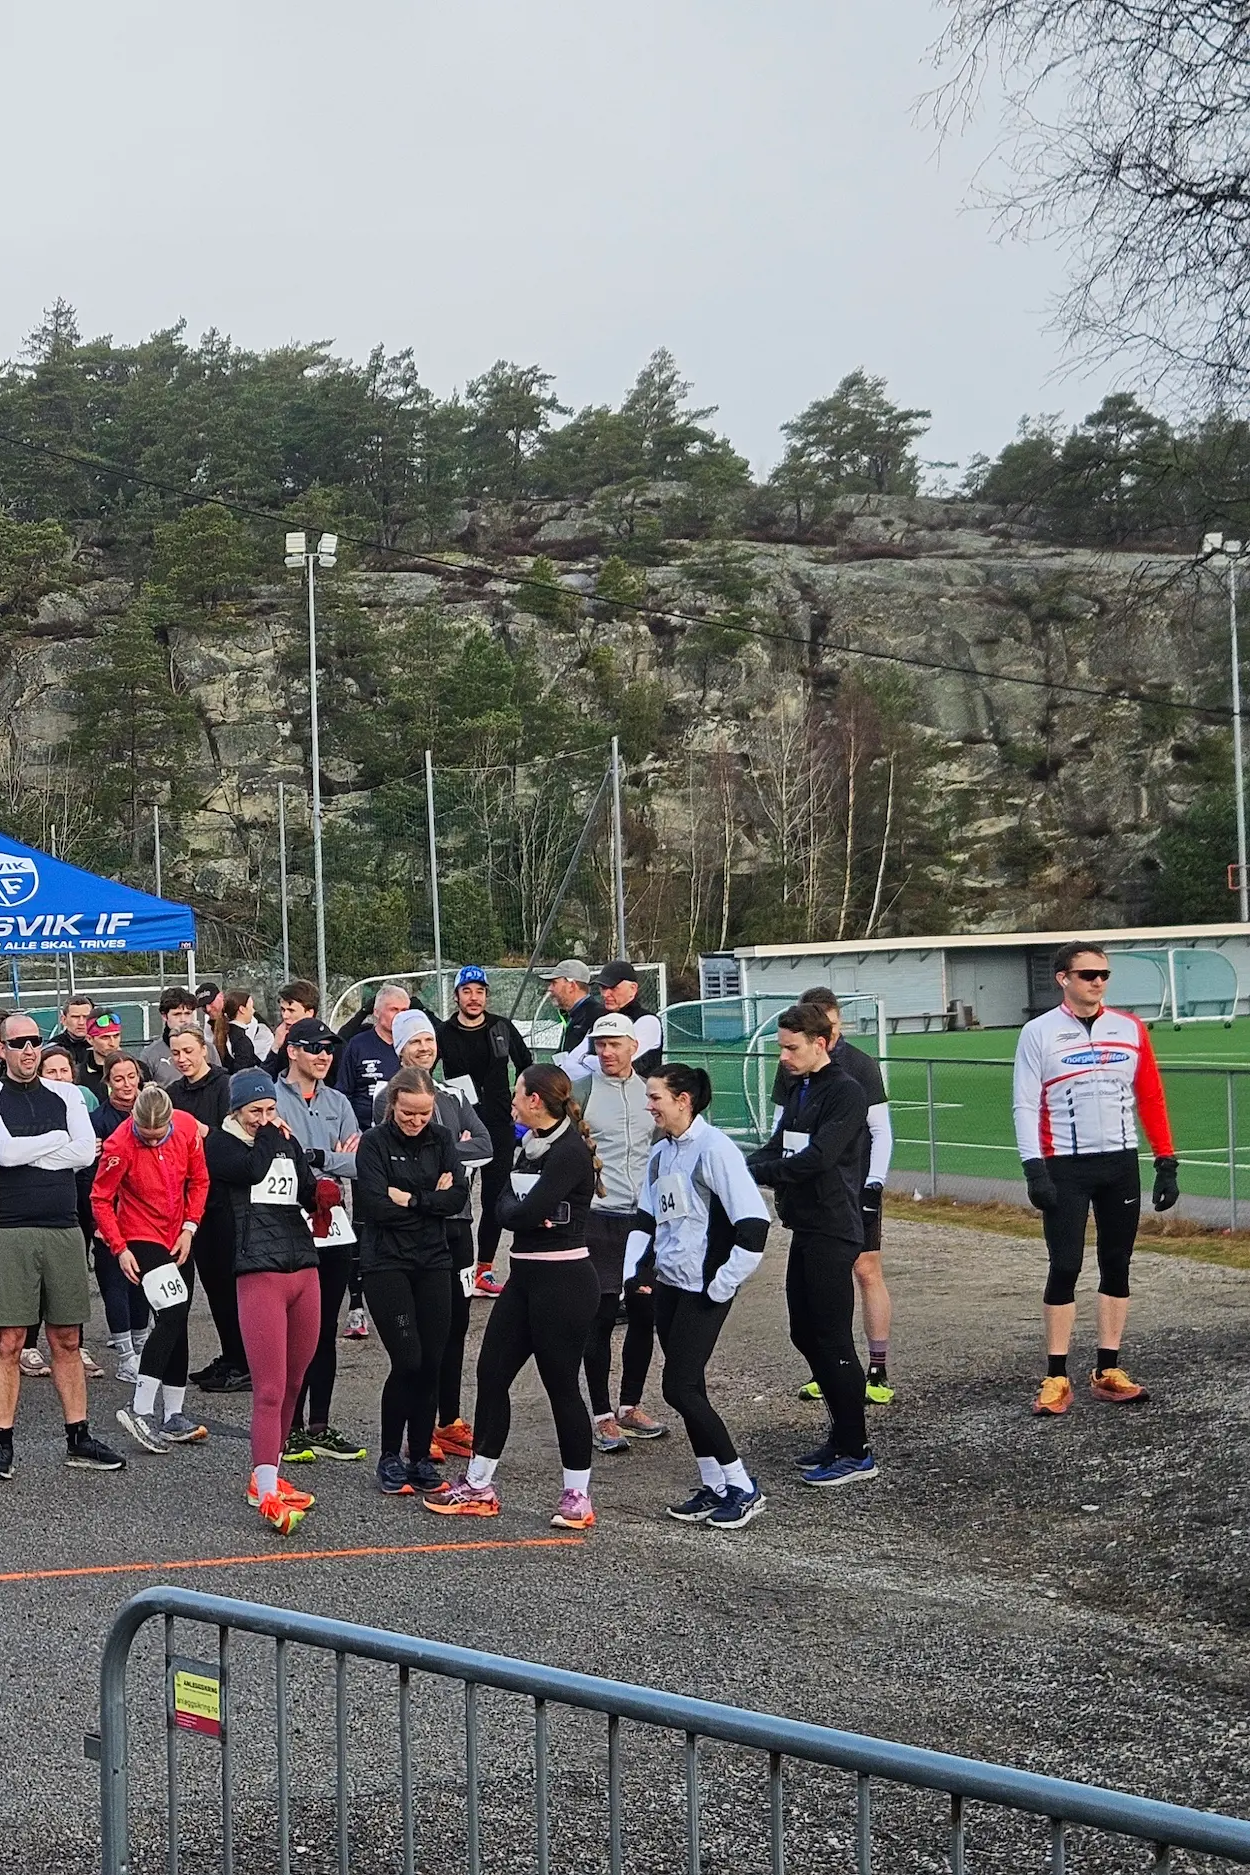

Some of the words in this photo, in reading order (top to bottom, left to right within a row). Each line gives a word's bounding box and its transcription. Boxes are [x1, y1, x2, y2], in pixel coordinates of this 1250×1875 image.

[95, 912, 134, 935] IF
[3, 941, 37, 951] ALLE
[40, 940, 76, 950] SKAL
[79, 939, 127, 949] TRIVES
[267, 1176, 293, 1196] 227
[658, 1191, 676, 1213] 84
[159, 1278, 183, 1299] 196
